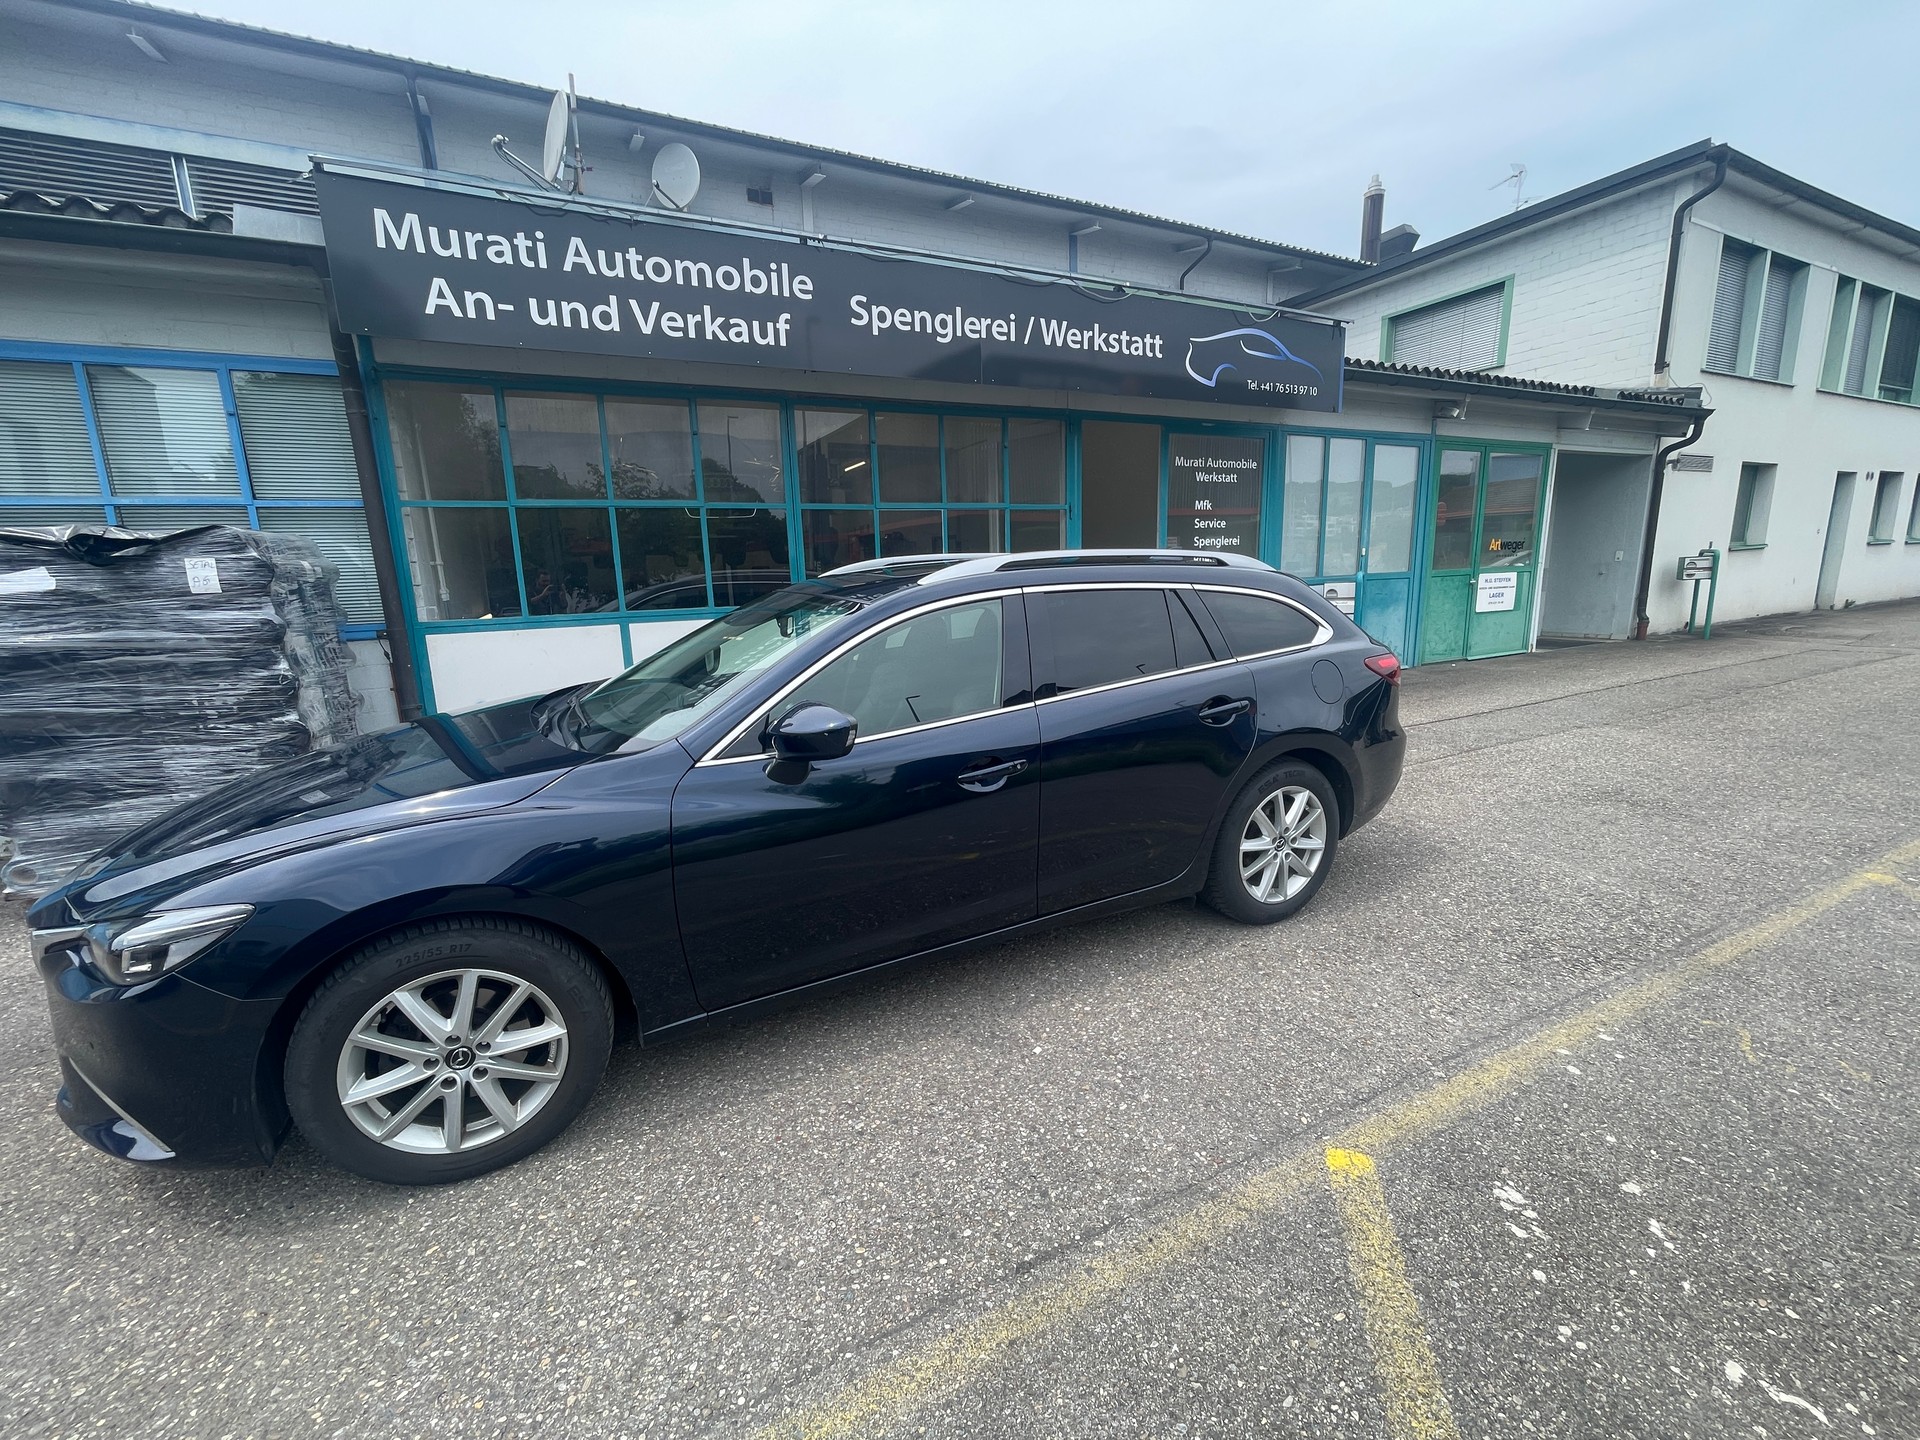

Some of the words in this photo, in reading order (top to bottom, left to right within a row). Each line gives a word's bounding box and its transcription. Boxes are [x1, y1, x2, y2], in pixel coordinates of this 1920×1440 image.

[373, 207, 548, 269] Murati
[562, 236, 814, 300] Automobile
[424, 277, 515, 321] An-
[528, 294, 621, 332] und
[628, 298, 791, 347] Verkauf
[850, 294, 1017, 344] Spenglerei
[1039, 317, 1163, 359] Werkstatt
[1246, 379, 1259, 391] Tel.
[1260, 382, 1274, 392] +41
[1275, 382, 1285, 393] 76
[1285, 384, 1298, 395] 513
[1299, 385, 1308, 395] 97
[1309, 386, 1318, 396] 10
[1174, 456, 1205, 468] Murati
[1206, 457, 1258, 470] Automobile
[1195, 471, 1238, 483] Werkstatt
[1194, 499, 1213, 511] Mfk
[1194, 517, 1227, 529] Service
[1193, 535, 1240, 549] Spenglerei
[1489, 538, 1525, 552] Artweger
[395, 946, 443, 968] 225/55
[449, 943, 473, 954] R17
